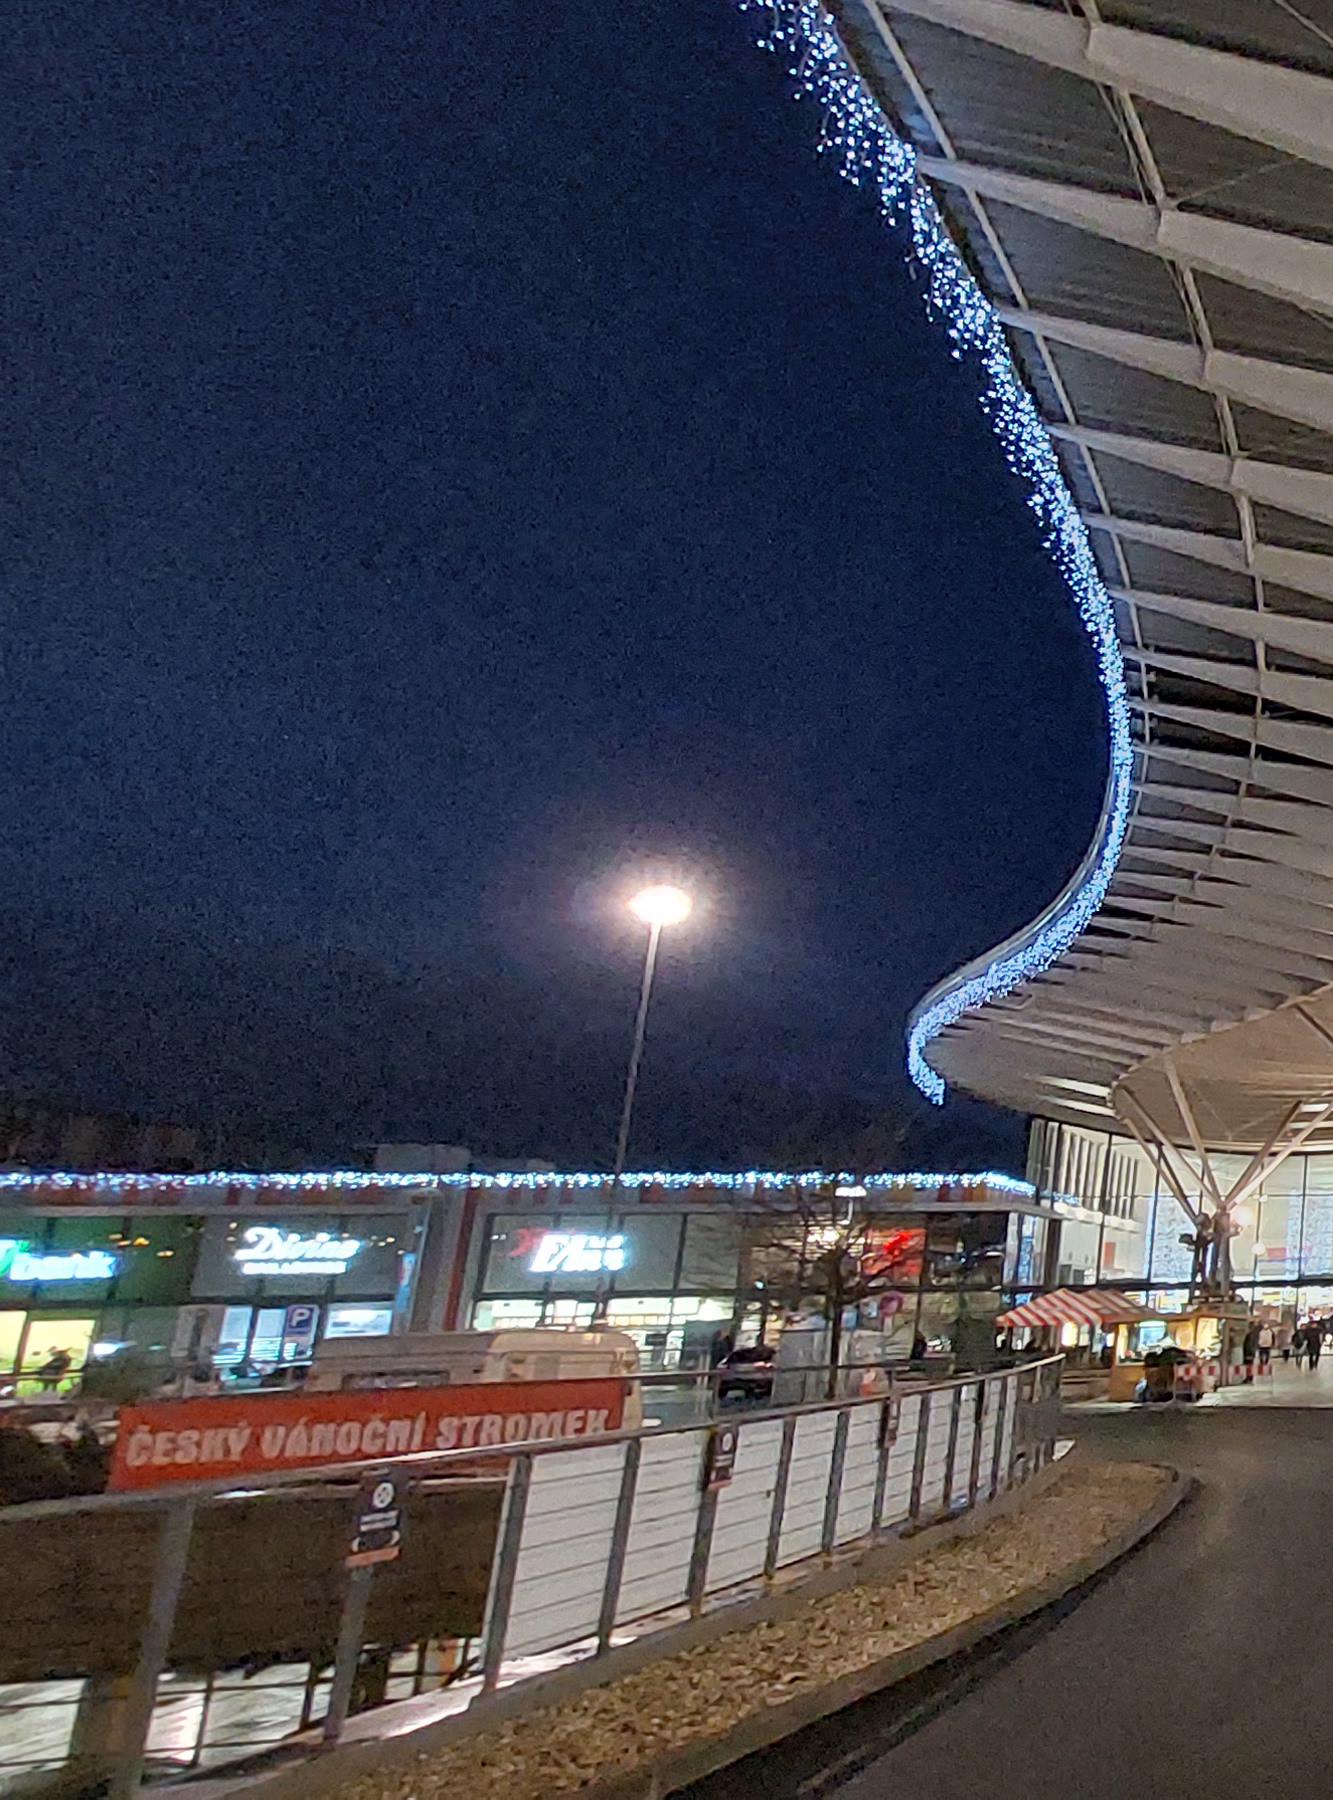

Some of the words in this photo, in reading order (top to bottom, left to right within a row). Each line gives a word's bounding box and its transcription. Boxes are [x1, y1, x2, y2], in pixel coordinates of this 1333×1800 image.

[125, 1420, 249, 1467] ČESKÝ
[260, 1411, 427, 1458] VÁNOČNÍ
[435, 1409, 609, 1449] STROMEK
